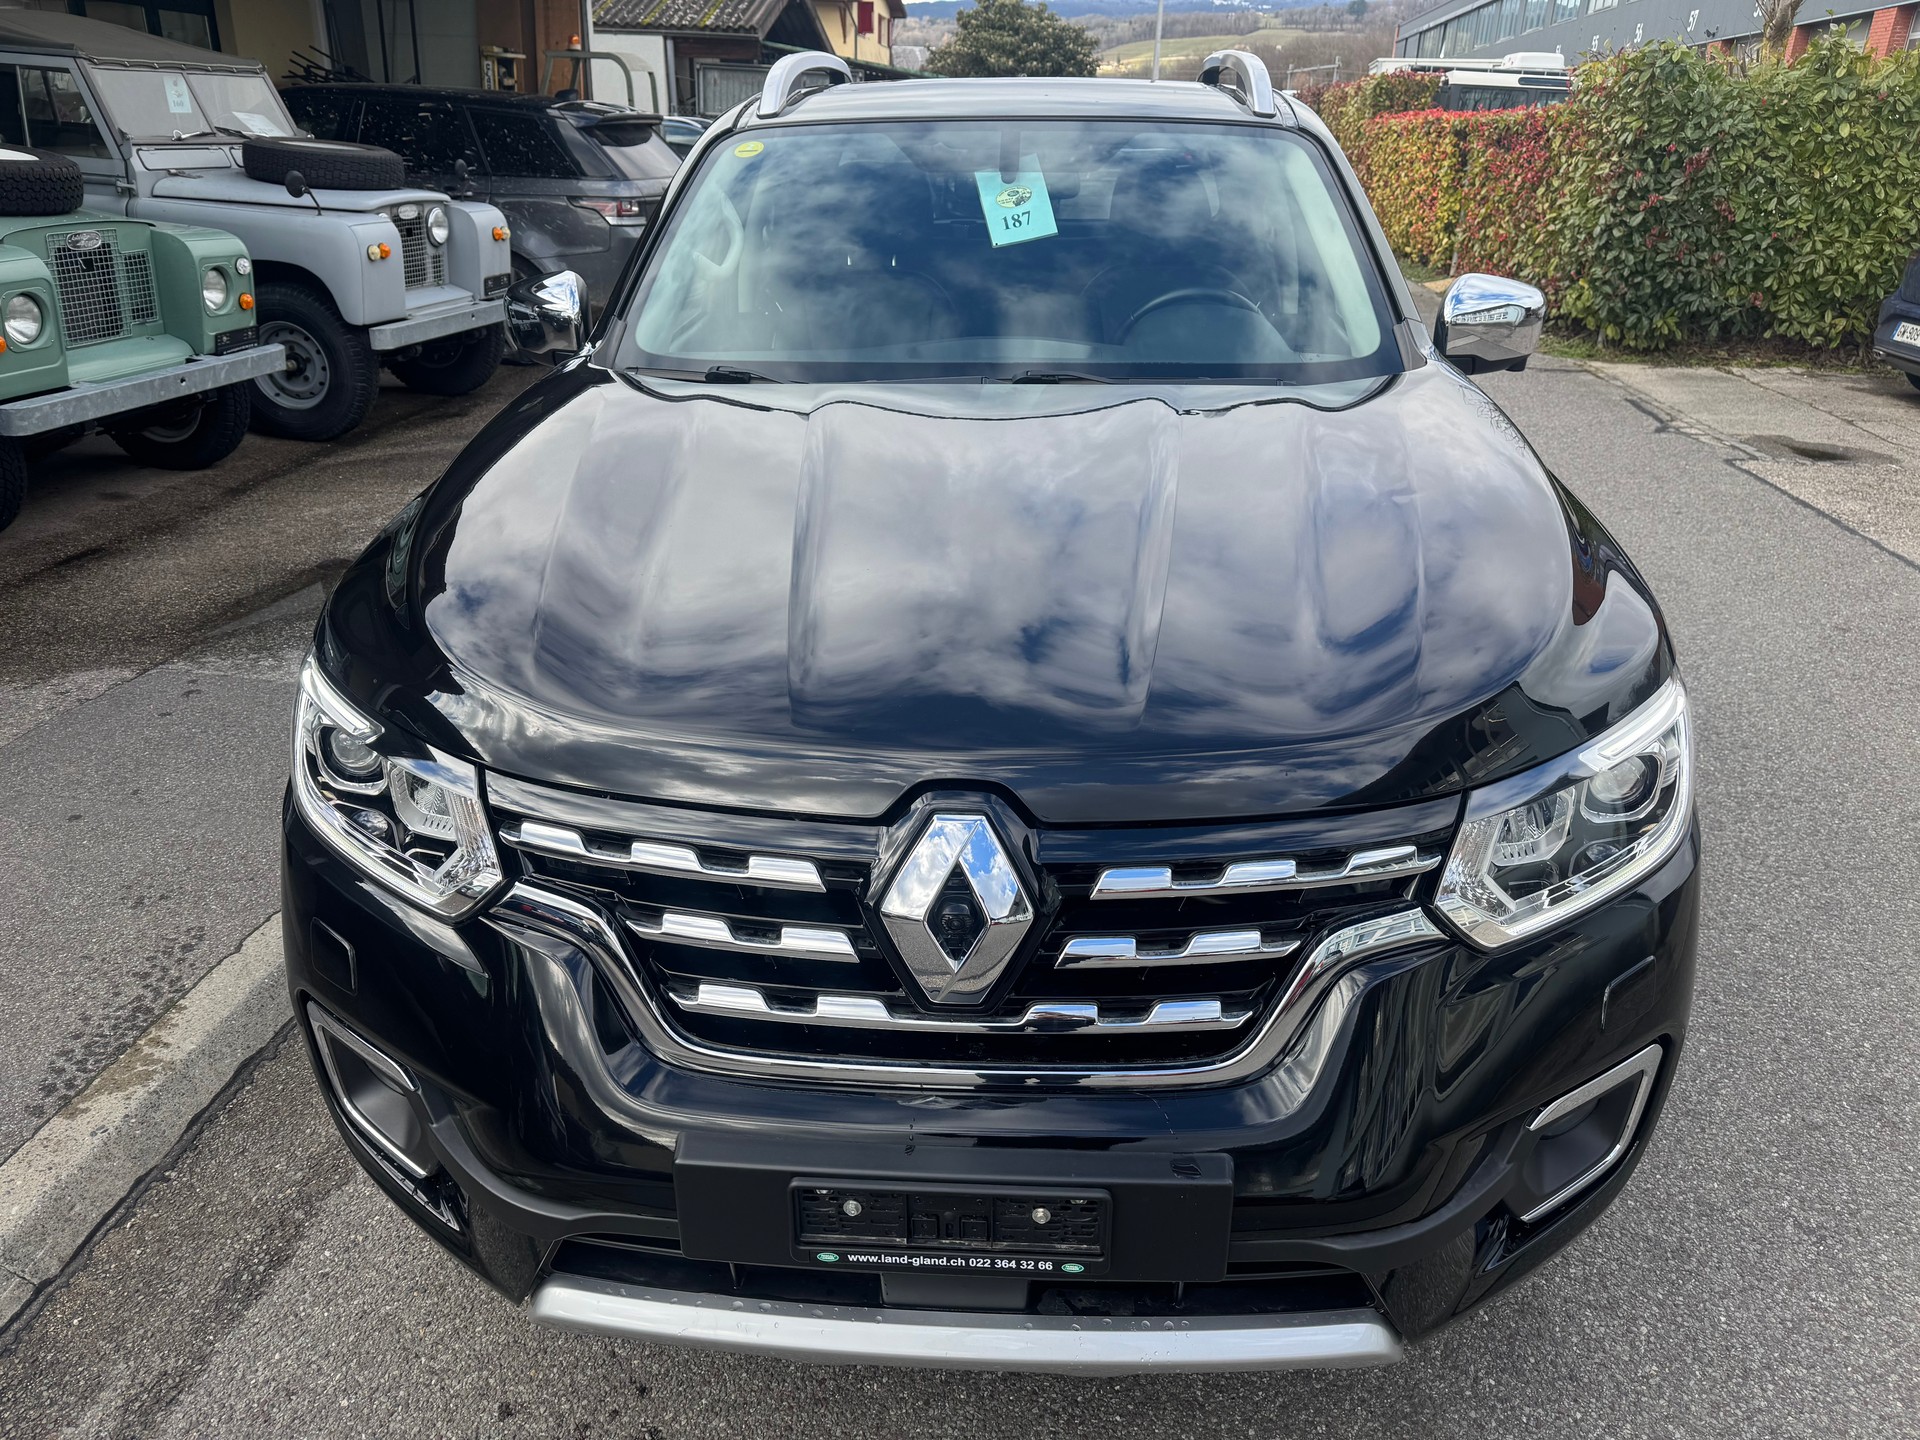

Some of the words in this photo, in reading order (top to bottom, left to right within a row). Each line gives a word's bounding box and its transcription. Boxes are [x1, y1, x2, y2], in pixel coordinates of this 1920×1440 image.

[1686, 9, 1699, 32] 57
[1591, 34, 1600, 51] 55
[1633, 22, 1644, 43] 56
[1001, 210, 1031, 231] 187
[847, 1254, 966, 1267] www.land-gland.ch
[969, 1258, 991, 1268] 022
[994, 1259, 1017, 1269] 364
[1020, 1260, 1035, 1270] 32
[1038, 1261, 1053, 1271] 66
